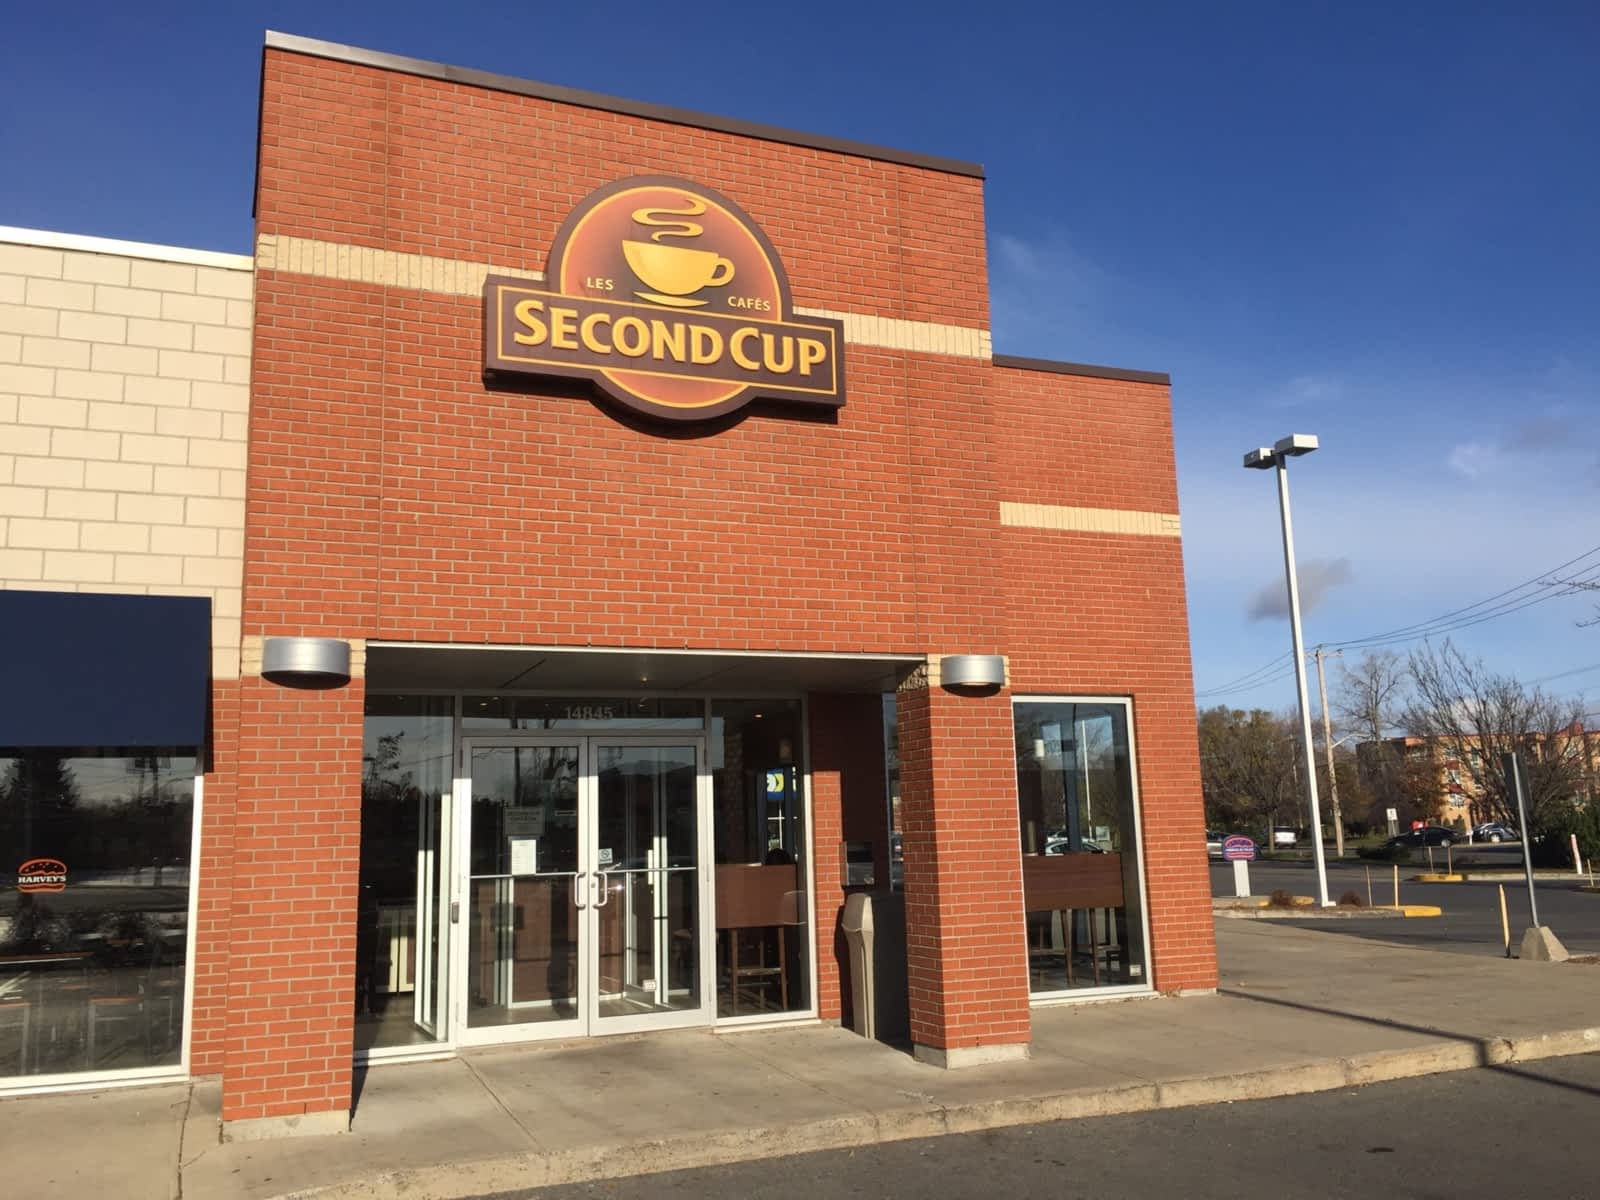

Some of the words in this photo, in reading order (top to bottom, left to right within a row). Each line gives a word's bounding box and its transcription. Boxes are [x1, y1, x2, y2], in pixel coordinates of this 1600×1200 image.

[586, 276, 615, 291] LES
[727, 295, 772, 312] CAFÉS
[513, 300, 724, 366] SECOND
[729, 327, 827, 376] CUP
[564, 705, 613, 720] 14845
[18, 875, 67, 884] HARVEY'S
